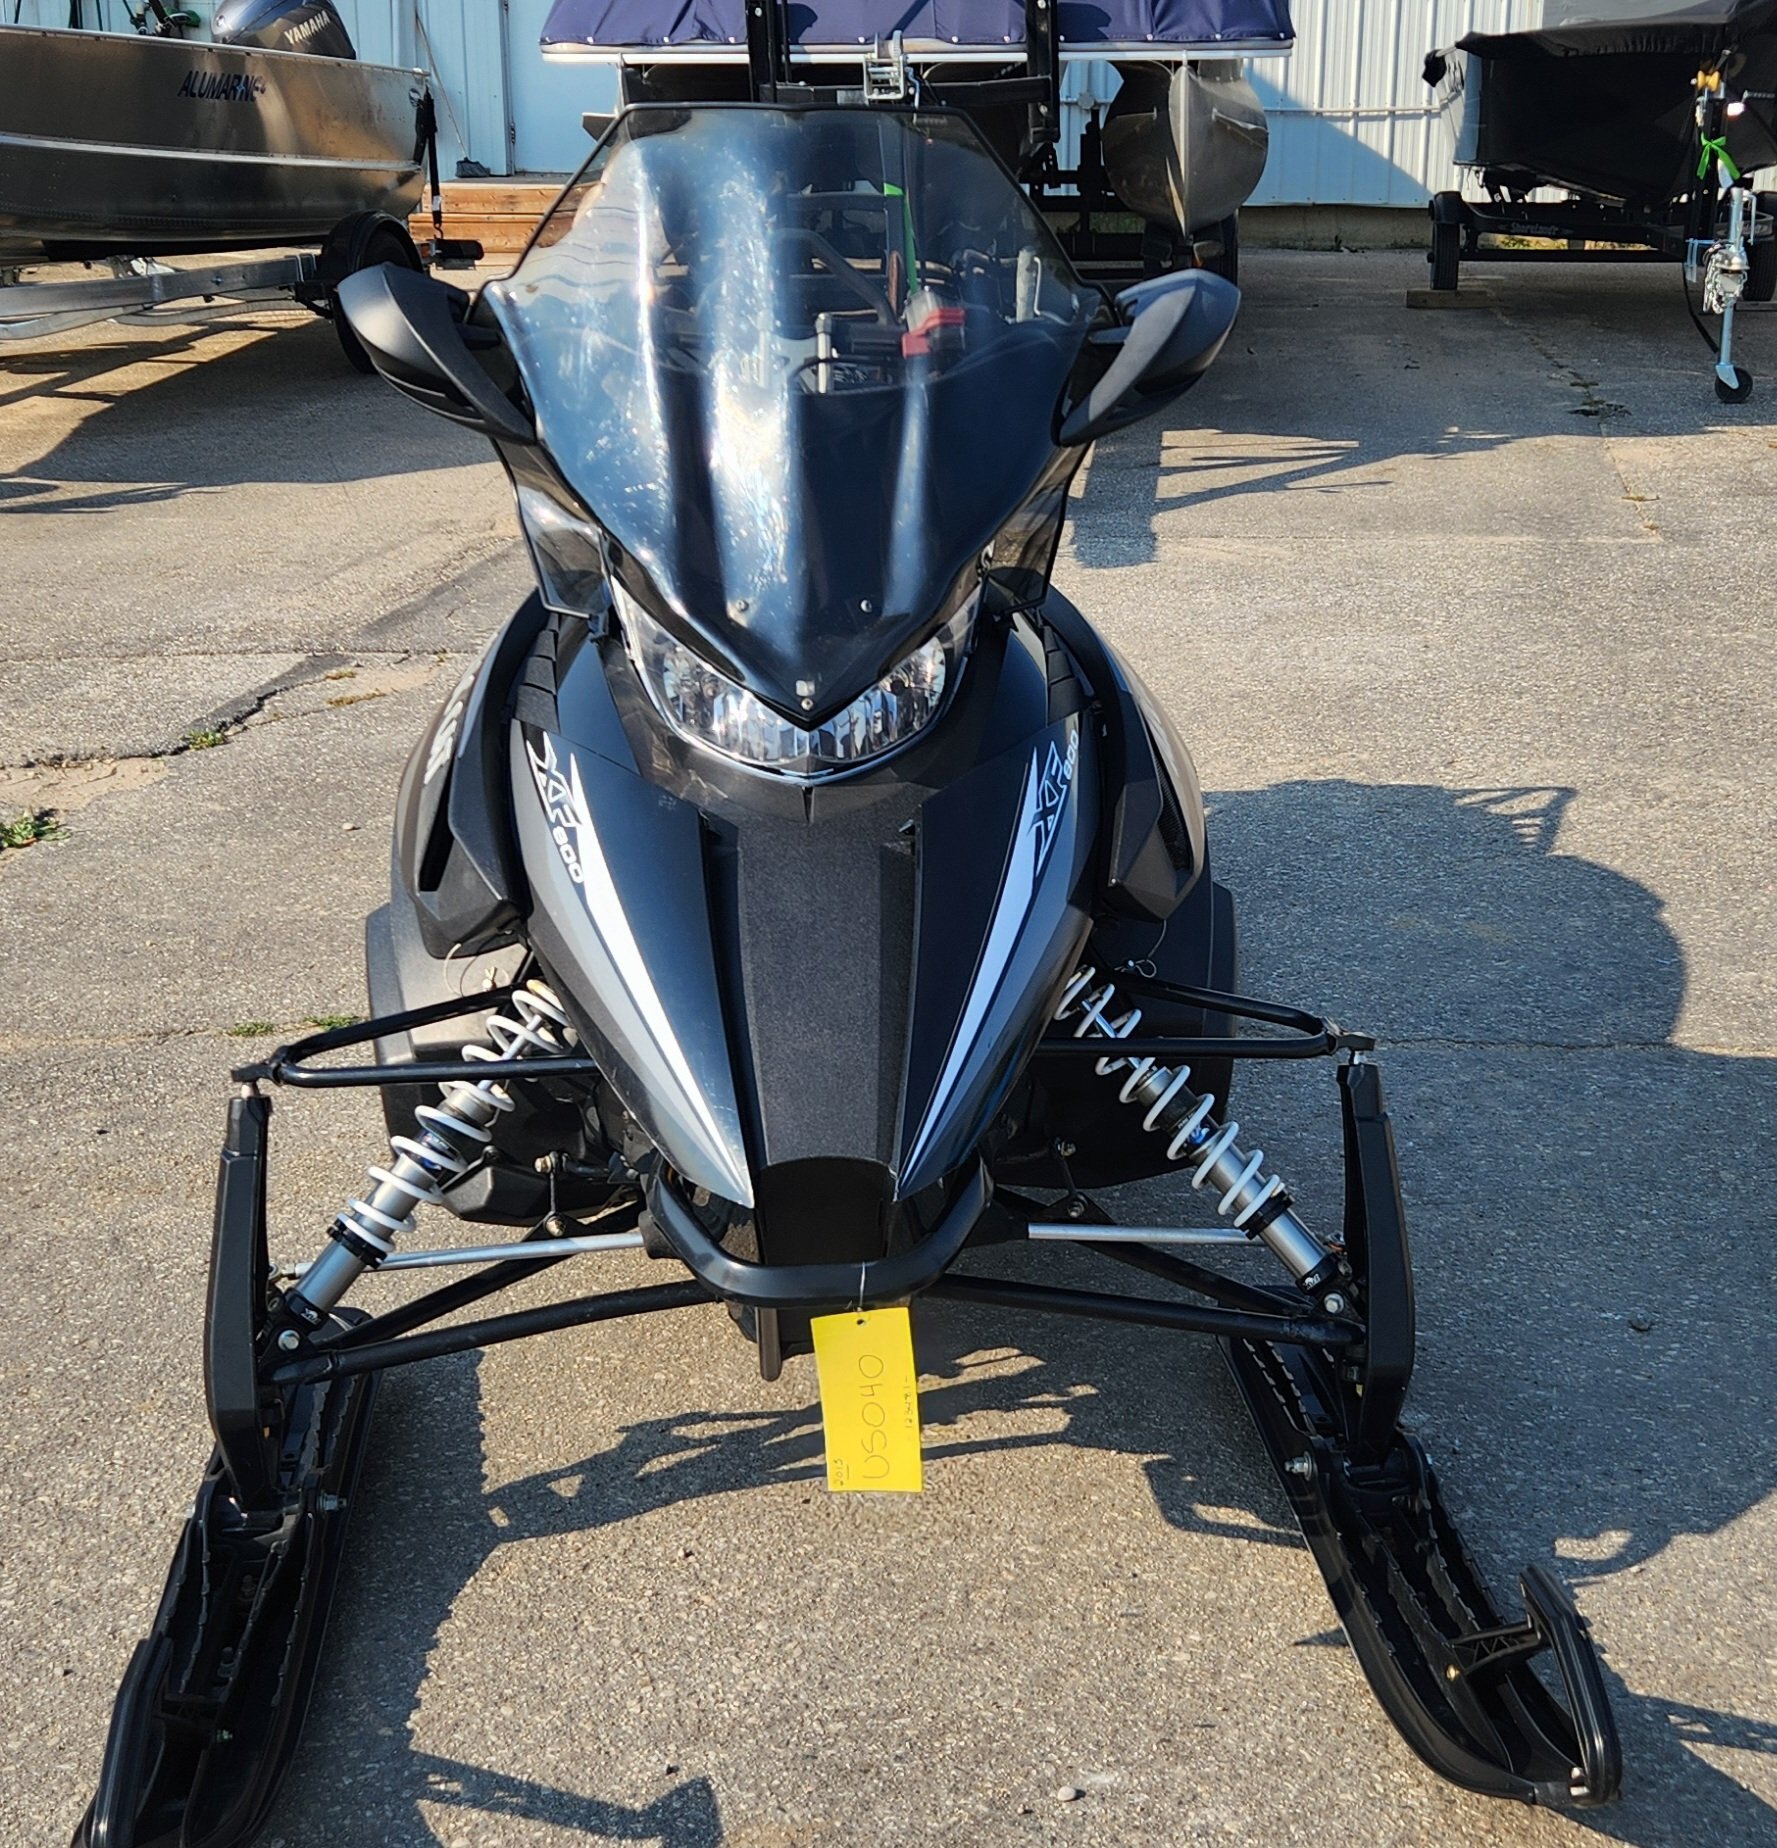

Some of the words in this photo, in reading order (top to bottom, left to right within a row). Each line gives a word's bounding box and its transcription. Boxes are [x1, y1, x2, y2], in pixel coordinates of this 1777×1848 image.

[284, 10, 331, 45] YAMAHA
[1063, 729, 1079, 780] 800
[552, 826, 584, 883] 800
